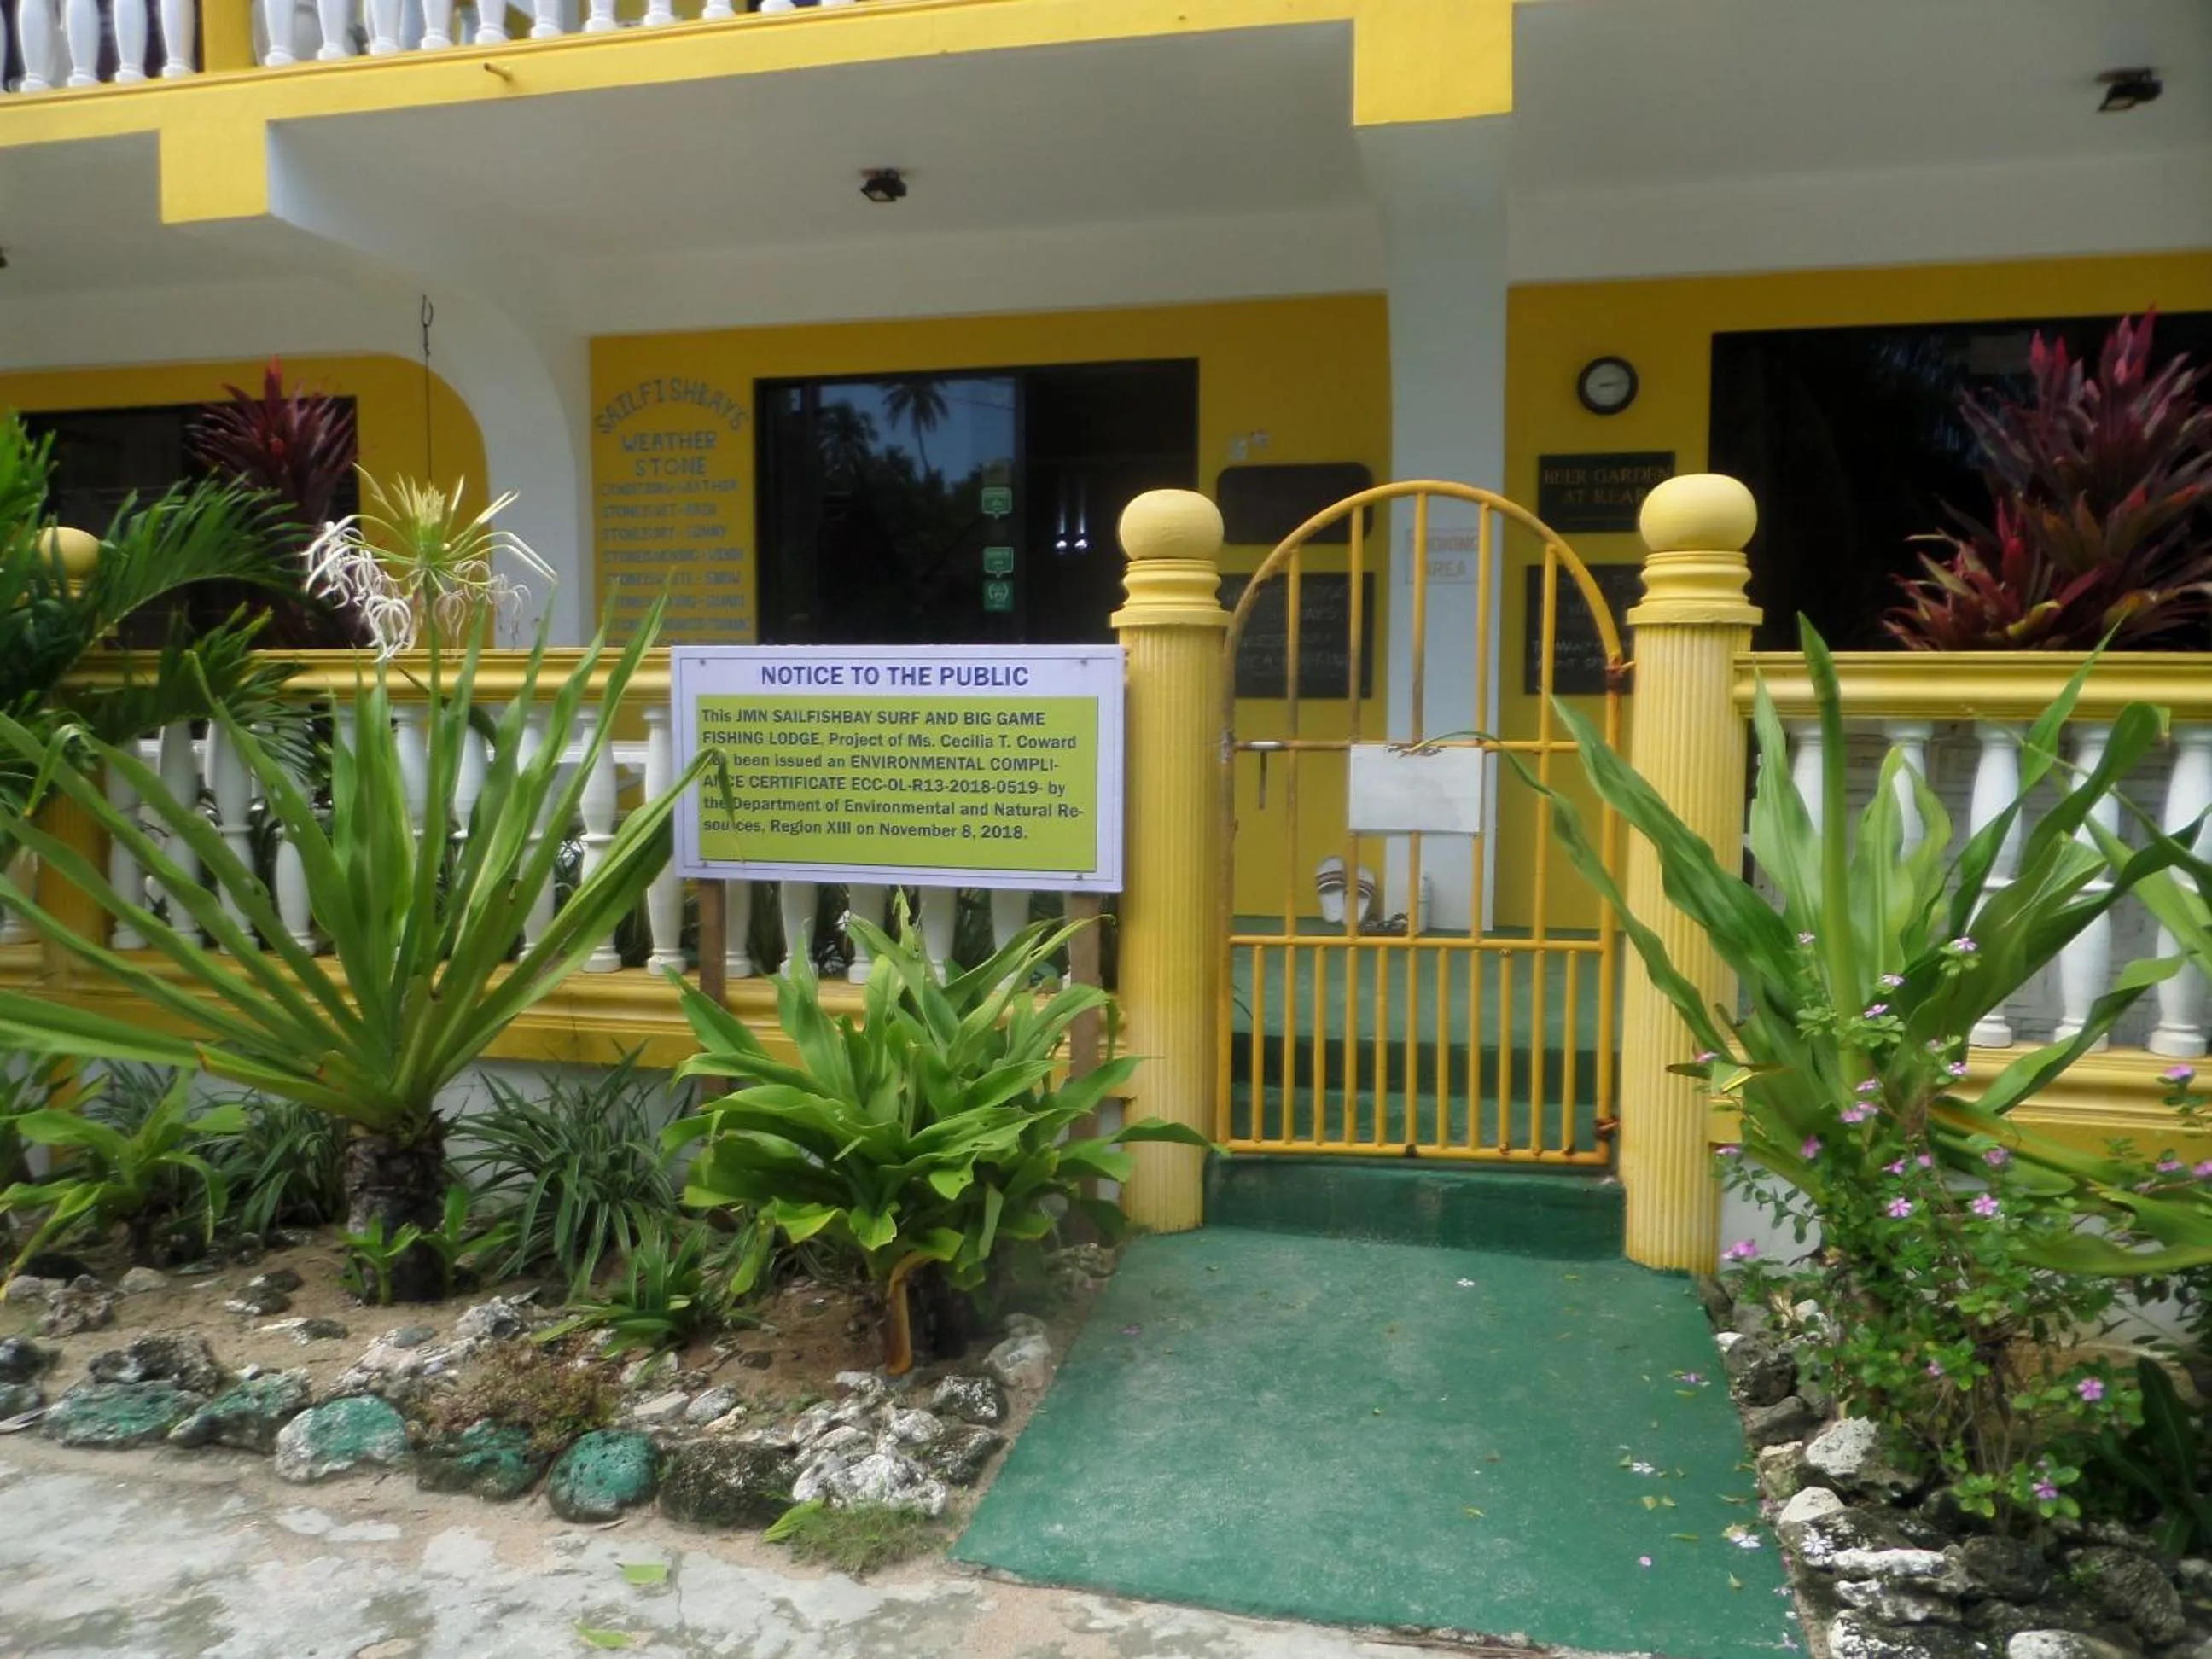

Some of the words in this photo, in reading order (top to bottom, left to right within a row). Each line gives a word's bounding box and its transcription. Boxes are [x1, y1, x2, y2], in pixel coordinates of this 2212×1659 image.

[621, 431, 718, 452] WEATHER
[635, 457, 707, 476] STONE
[761, 666, 844, 685] NOTICE
[851, 667, 880, 685] TO
[887, 667, 932, 686] THE
[940, 667, 1029, 686] PUBLIC
[701, 709, 731, 723] This
[735, 709, 767, 723] JMN
[773, 709, 872, 724] SAILFISHBAY
[877, 710, 920, 725] SURF
[926, 711, 958, 725] AND
[963, 712, 991, 725] BIG
[997, 712, 1045, 725] GAME
[702, 731, 764, 745] FISHING
[829, 732, 882, 748] Project
[888, 733, 903, 747] of
[908, 734, 935, 748] Ms.
[940, 734, 993, 748] Cecilia
[998, 735, 1011, 748] T.
[1016, 735, 1077, 749] Coward
[734, 754, 769, 767] been
[775, 754, 822, 767] issued
[827, 757, 845, 767] an
[851, 755, 985, 771] ENVIRONMENTAL
[990, 757, 1059, 771] COMPLI-
[703, 775, 745, 788] AE
[749, 776, 846, 789] CERTIFICATE
[1048, 781, 1066, 797] by
[703, 796, 726, 809] the
[732, 797, 821, 812] Department
[825, 799, 840, 812] of
[845, 799, 955, 815] Environmental
[960, 802, 988, 816] and
[994, 802, 1051, 817] Natural
[1058, 804, 1084, 818] Re-
[771, 820, 821, 835] Region
[827, 821, 851, 835] XIII
[857, 824, 874, 835] on
[880, 822, 958, 837] November
[961, 824, 976, 840] 8,
[981, 825, 1027, 839] 2018.
